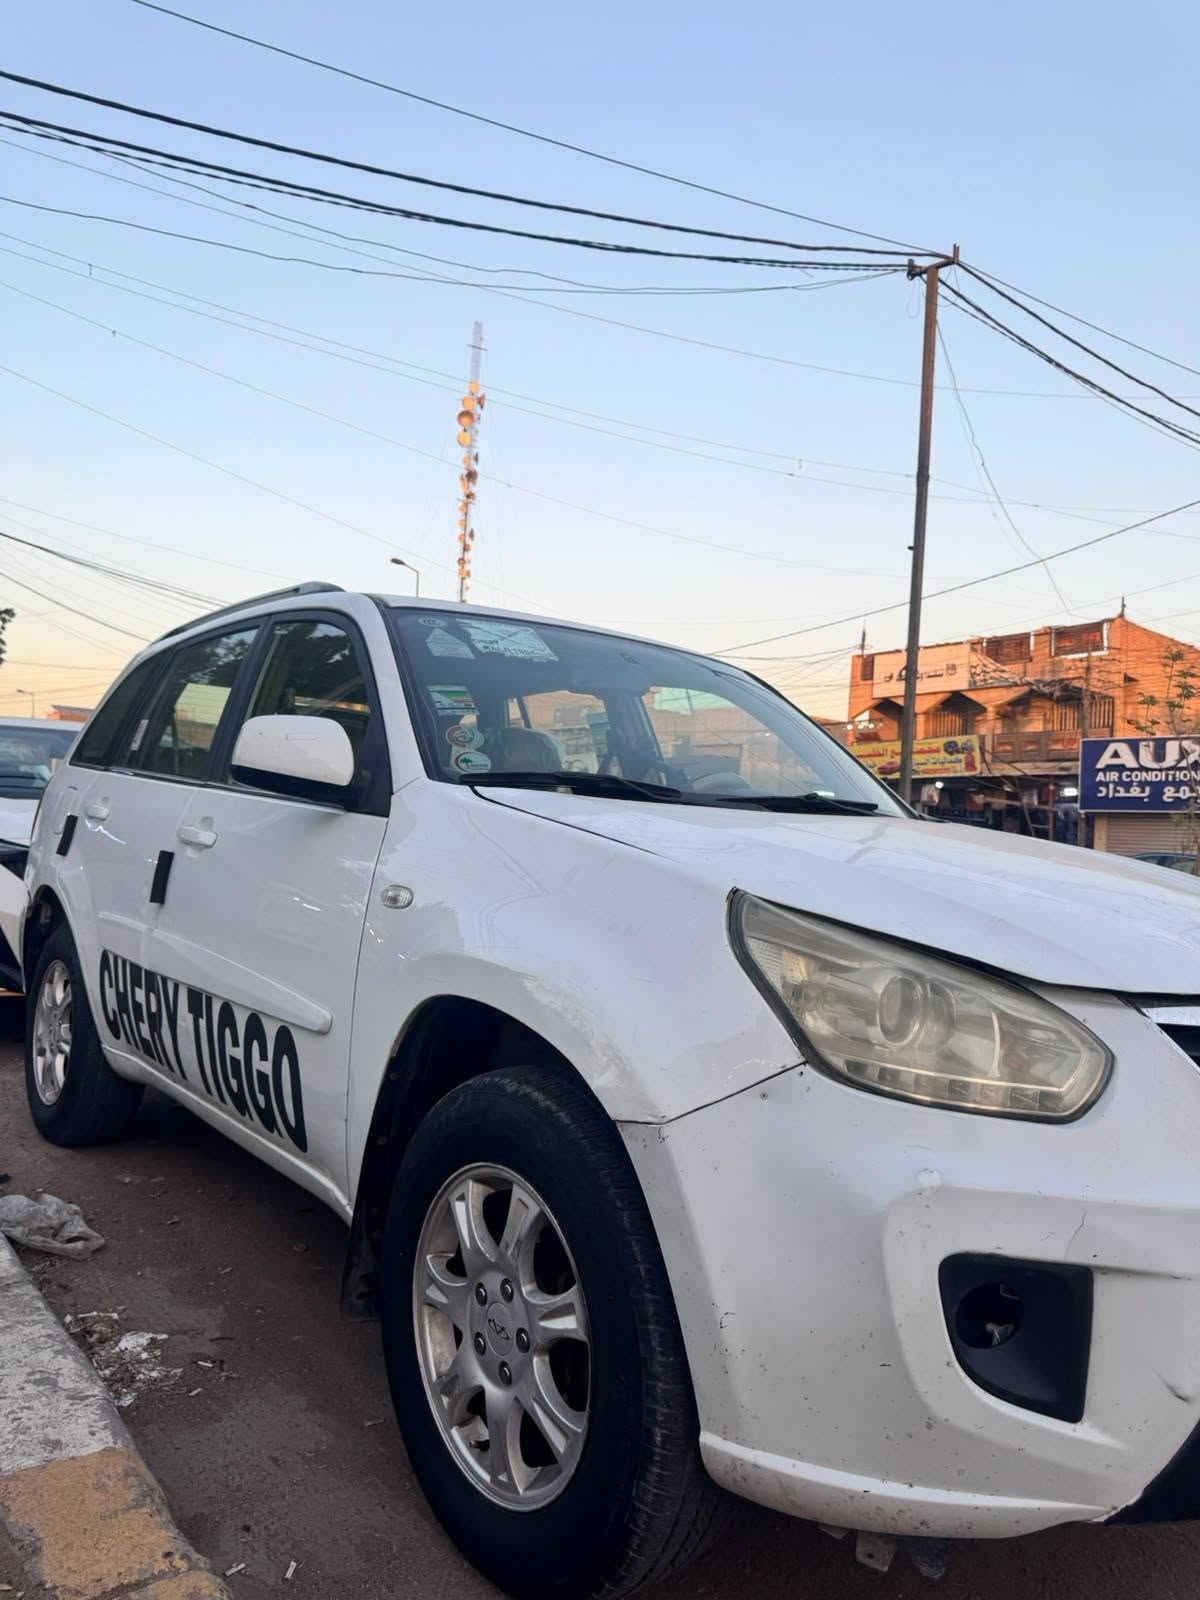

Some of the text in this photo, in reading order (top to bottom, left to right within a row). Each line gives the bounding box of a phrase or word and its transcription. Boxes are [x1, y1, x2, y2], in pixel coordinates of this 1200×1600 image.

[1096, 771, 1119, 782] AIR
[1096, 782, 1151, 802] بغداد
[100, 949, 308, 1153] CHERY TIGGO
